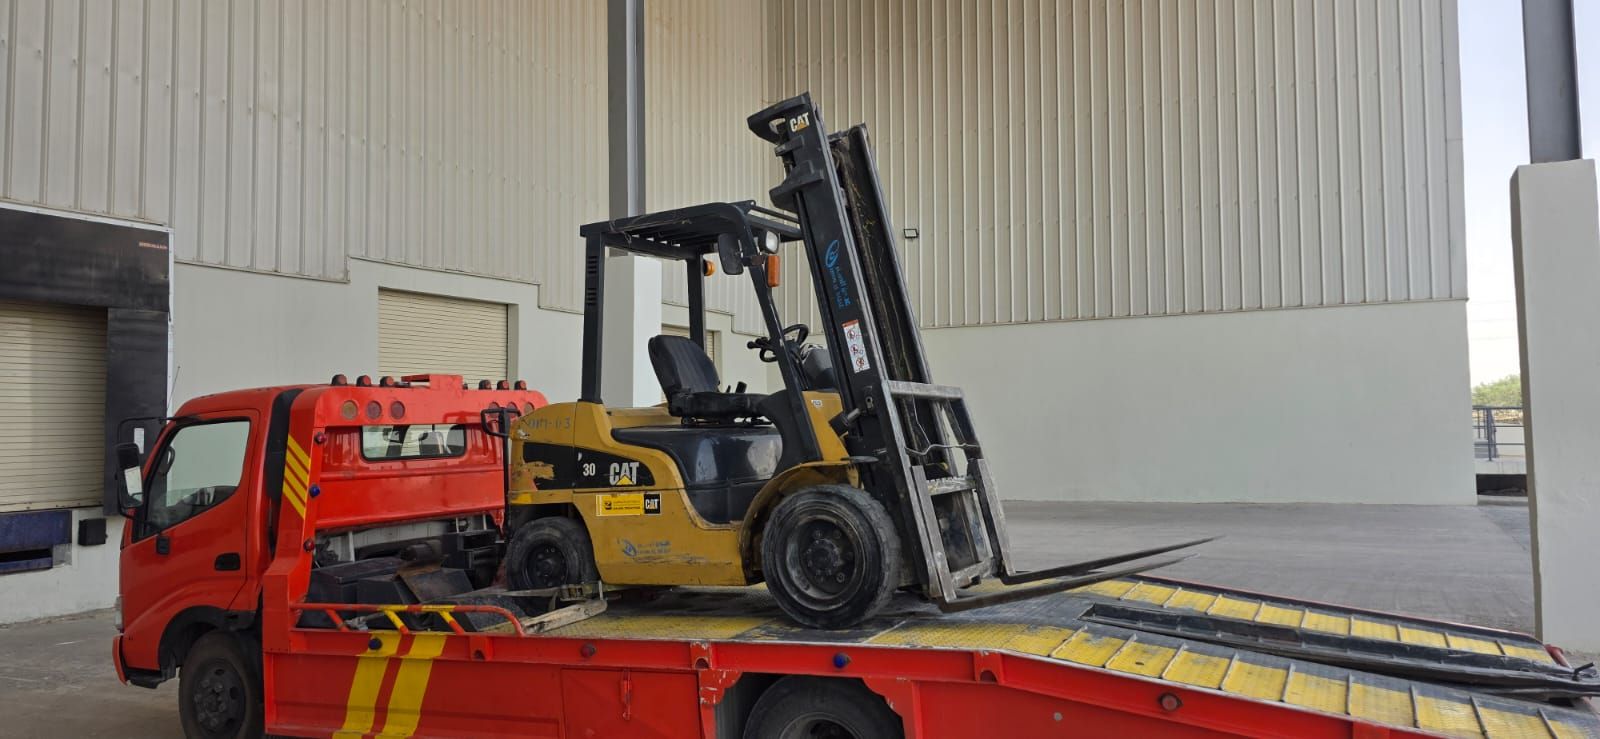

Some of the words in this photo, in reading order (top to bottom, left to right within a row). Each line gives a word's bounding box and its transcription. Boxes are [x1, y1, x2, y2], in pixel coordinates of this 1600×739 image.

[790, 112, 810, 132] CAT
[583, 463, 596, 477] 30
[610, 462, 639, 485] CAT
[645, 498, 659, 510] CAT
